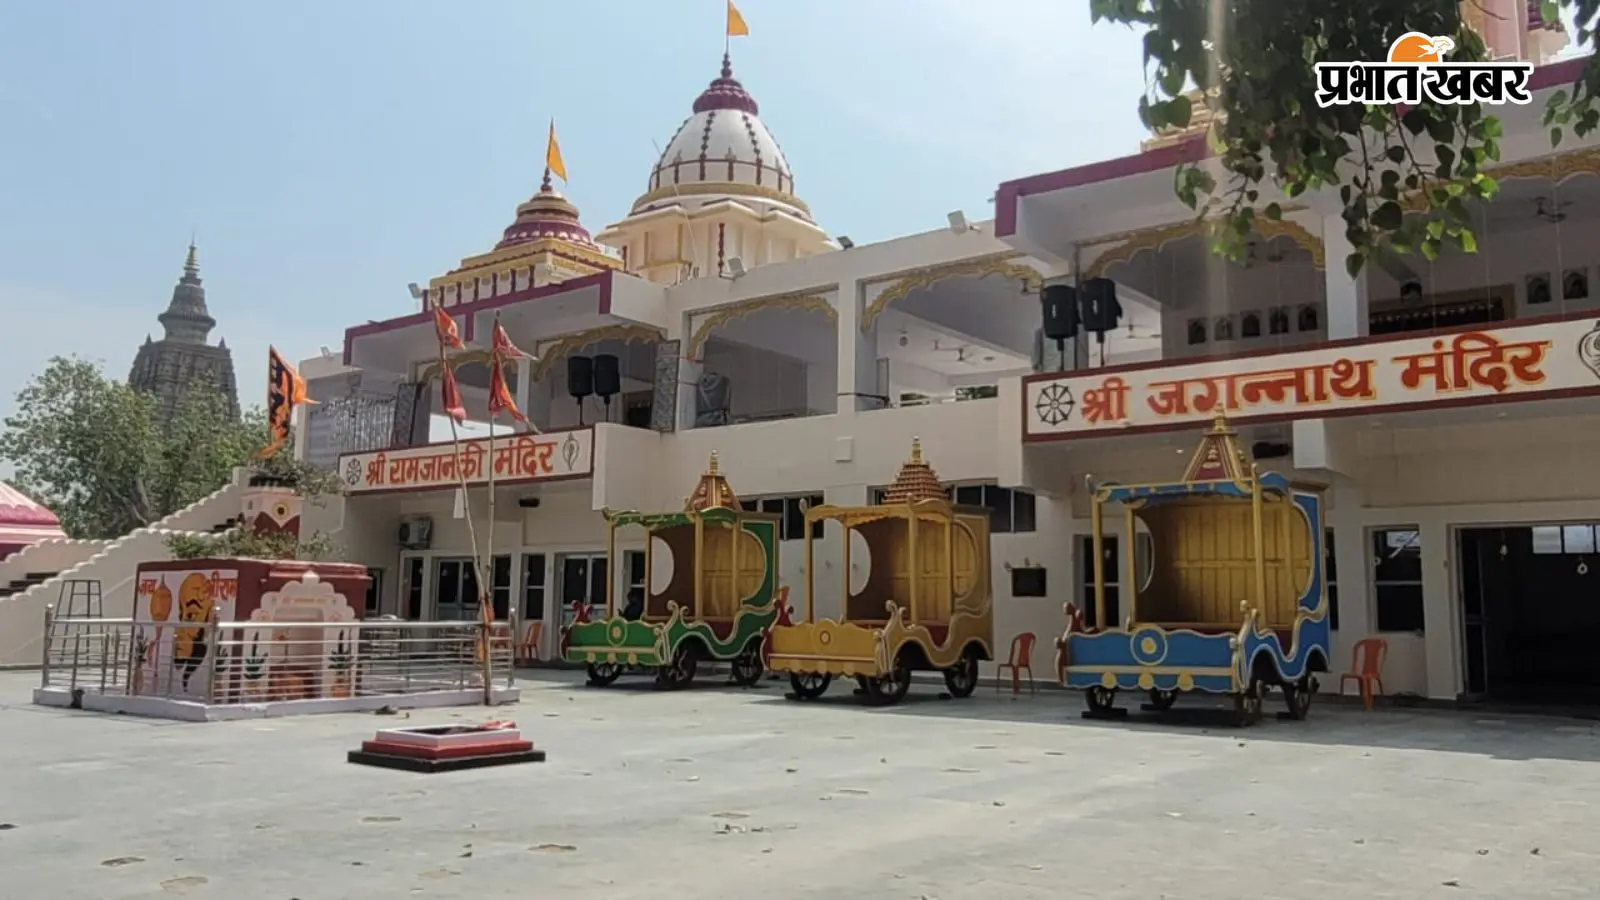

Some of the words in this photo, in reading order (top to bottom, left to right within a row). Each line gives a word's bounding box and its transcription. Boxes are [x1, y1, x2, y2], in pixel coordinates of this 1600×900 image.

[1081, 376, 1131, 423] श्री
[1147, 357, 1376, 416] जगन्नाथ
[1393, 332, 1552, 392] मंदिर
[366, 452, 387, 486] श्री
[389, 442, 488, 485] रामजानकी
[493, 438, 557, 476] मंदिर
